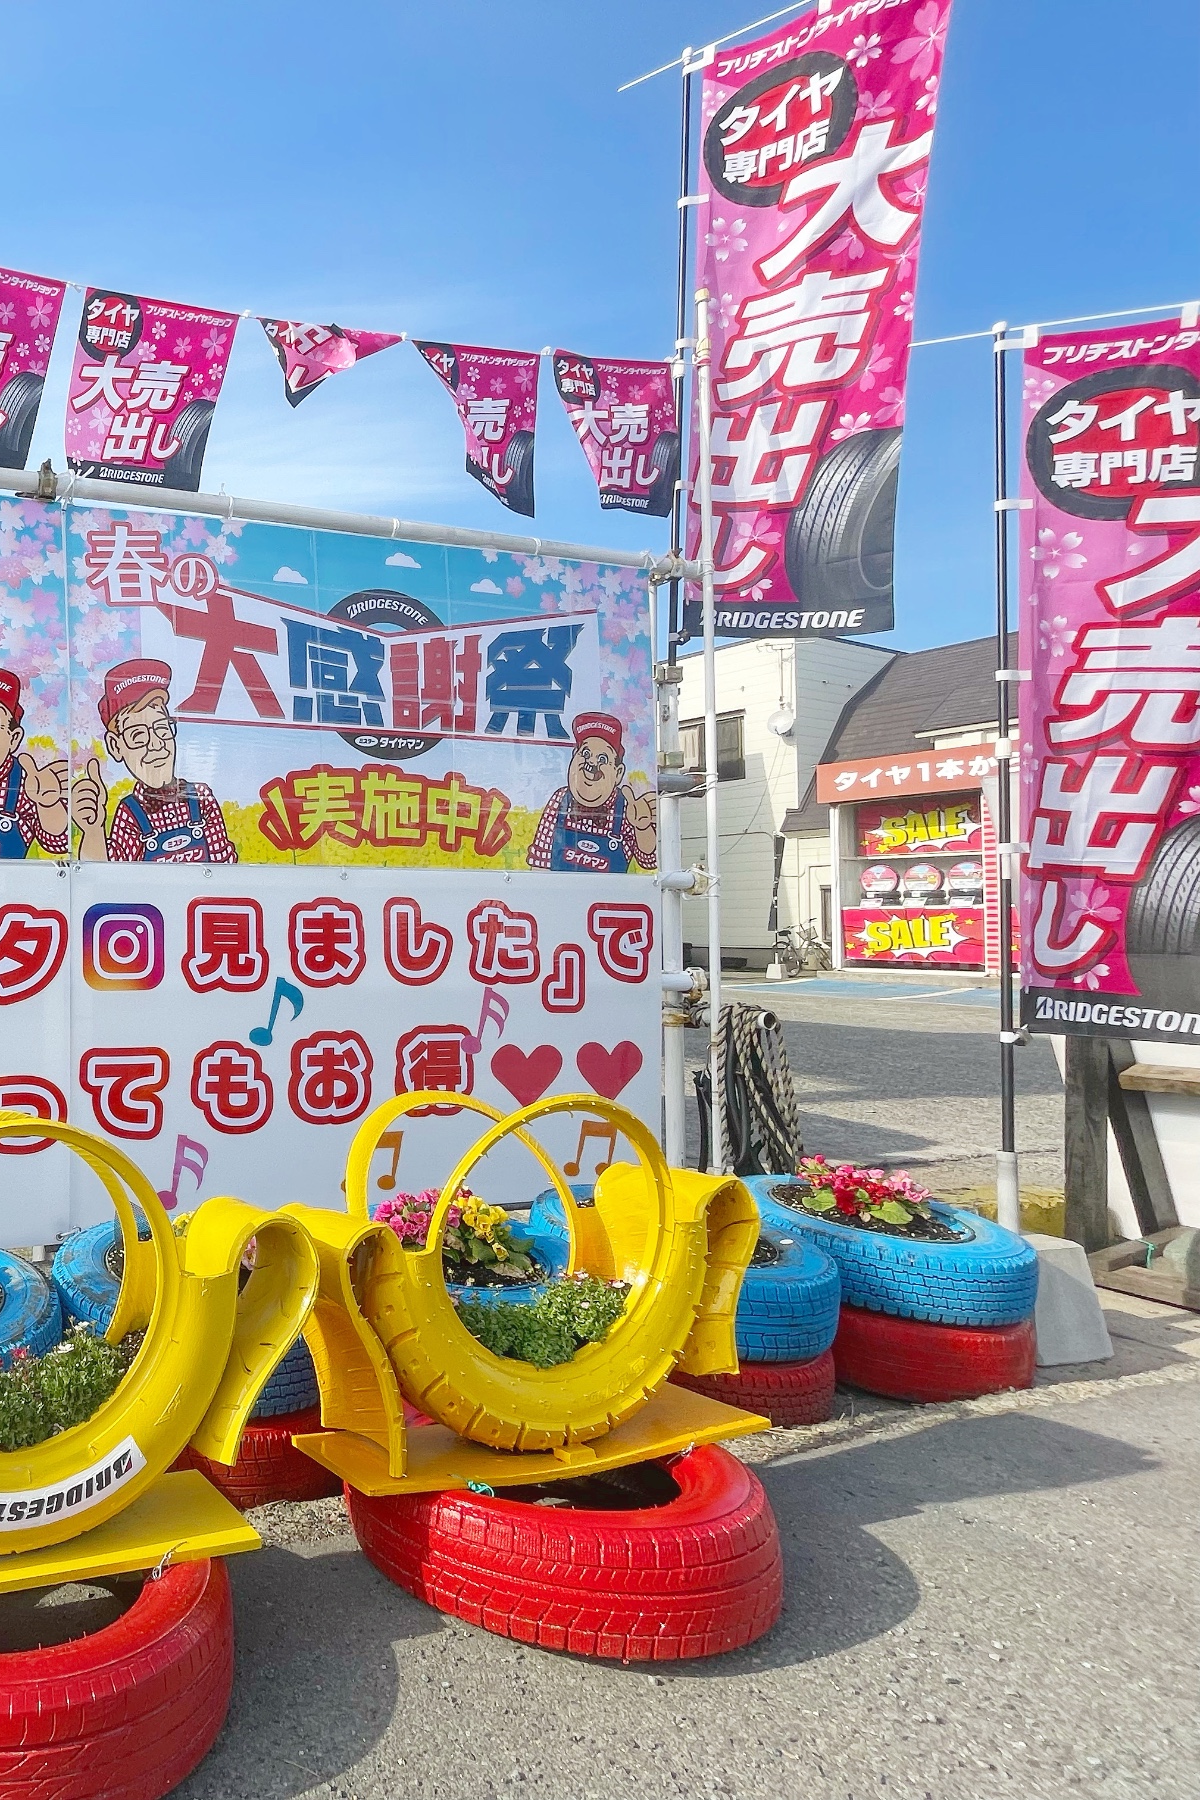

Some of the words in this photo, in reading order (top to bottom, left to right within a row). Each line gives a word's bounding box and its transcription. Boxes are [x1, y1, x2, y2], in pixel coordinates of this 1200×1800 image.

[718, 66, 845, 147] タイヤ
[722, 118, 831, 184] 専門店
[87, 298, 140, 327] タイヤ
[85, 325, 132, 349] 専門店
[691, 120, 934, 590] 大売出し
[71, 354, 190, 411] 大売
[557, 359, 594, 380] タイヤ
[560, 378, 597, 397] 専門店
[101, 412, 181, 461] 出し
[568, 401, 649, 445] 大売
[1046, 389, 1200, 445] タイヤ
[99, 466, 165, 485] BRIDGESTONE
[599, 446, 660, 489] 出し
[1051, 444, 1198, 489] 専門店
[86, 521, 219, 607] 春の
[346, 601, 429, 628] BRIDGESTONE
[113, 674, 169, 695] BRIDGESTONE
[157, 595, 585, 739] 大感謝祭
[379, 737, 425, 750] タイヤマン
[293, 769, 481, 846] 実施中
[881, 804, 968, 847] SALE
[565, 849, 608, 870] タイヤマン
[867, 915, 952, 953] SALE
